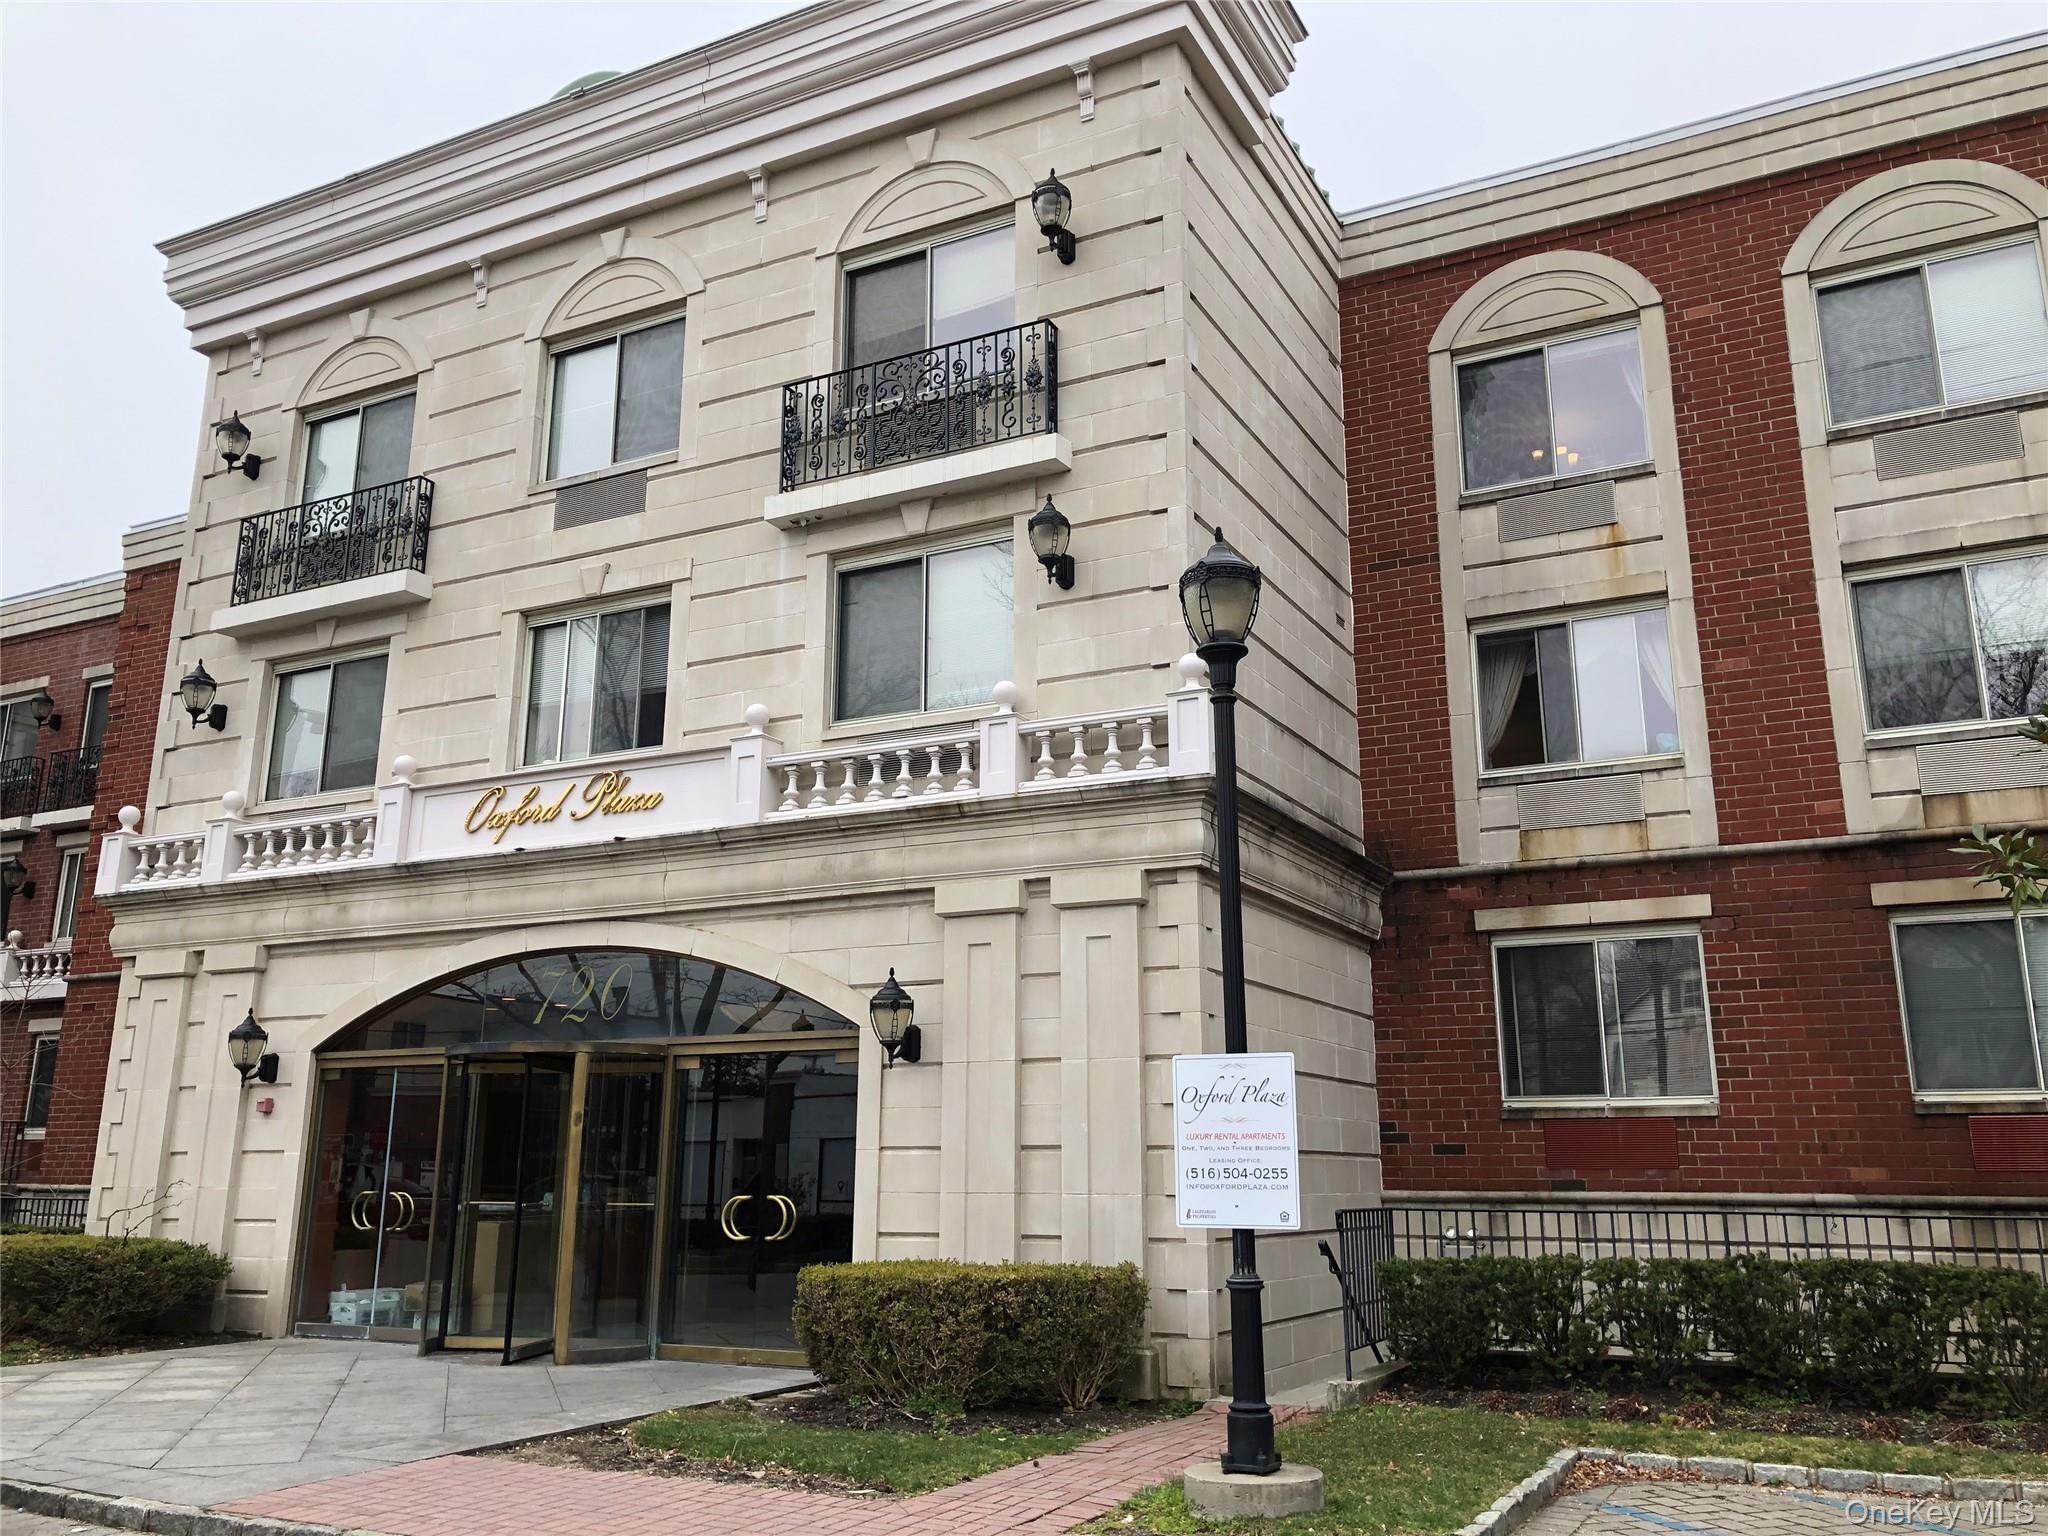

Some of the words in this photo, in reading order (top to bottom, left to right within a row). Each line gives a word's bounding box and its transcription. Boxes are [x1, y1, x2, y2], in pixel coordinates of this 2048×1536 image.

[464, 783, 576, 845] Oxford
[569, 769, 664, 821] Plaza
[533, 963, 633, 1025] 720
[1181, 1075, 1246, 1125] Oxford
[1242, 1077, 1289, 1107] Plaza
[1185, 1132, 1213, 1141] LUXURY
[1214, 1132, 1240, 1141] RENTAL
[1240, 1132, 1286, 1141] APARTMENTS
[1185, 1167, 1221, 1180] (516)
[1223, 1167, 1289, 1180] 504-0255
